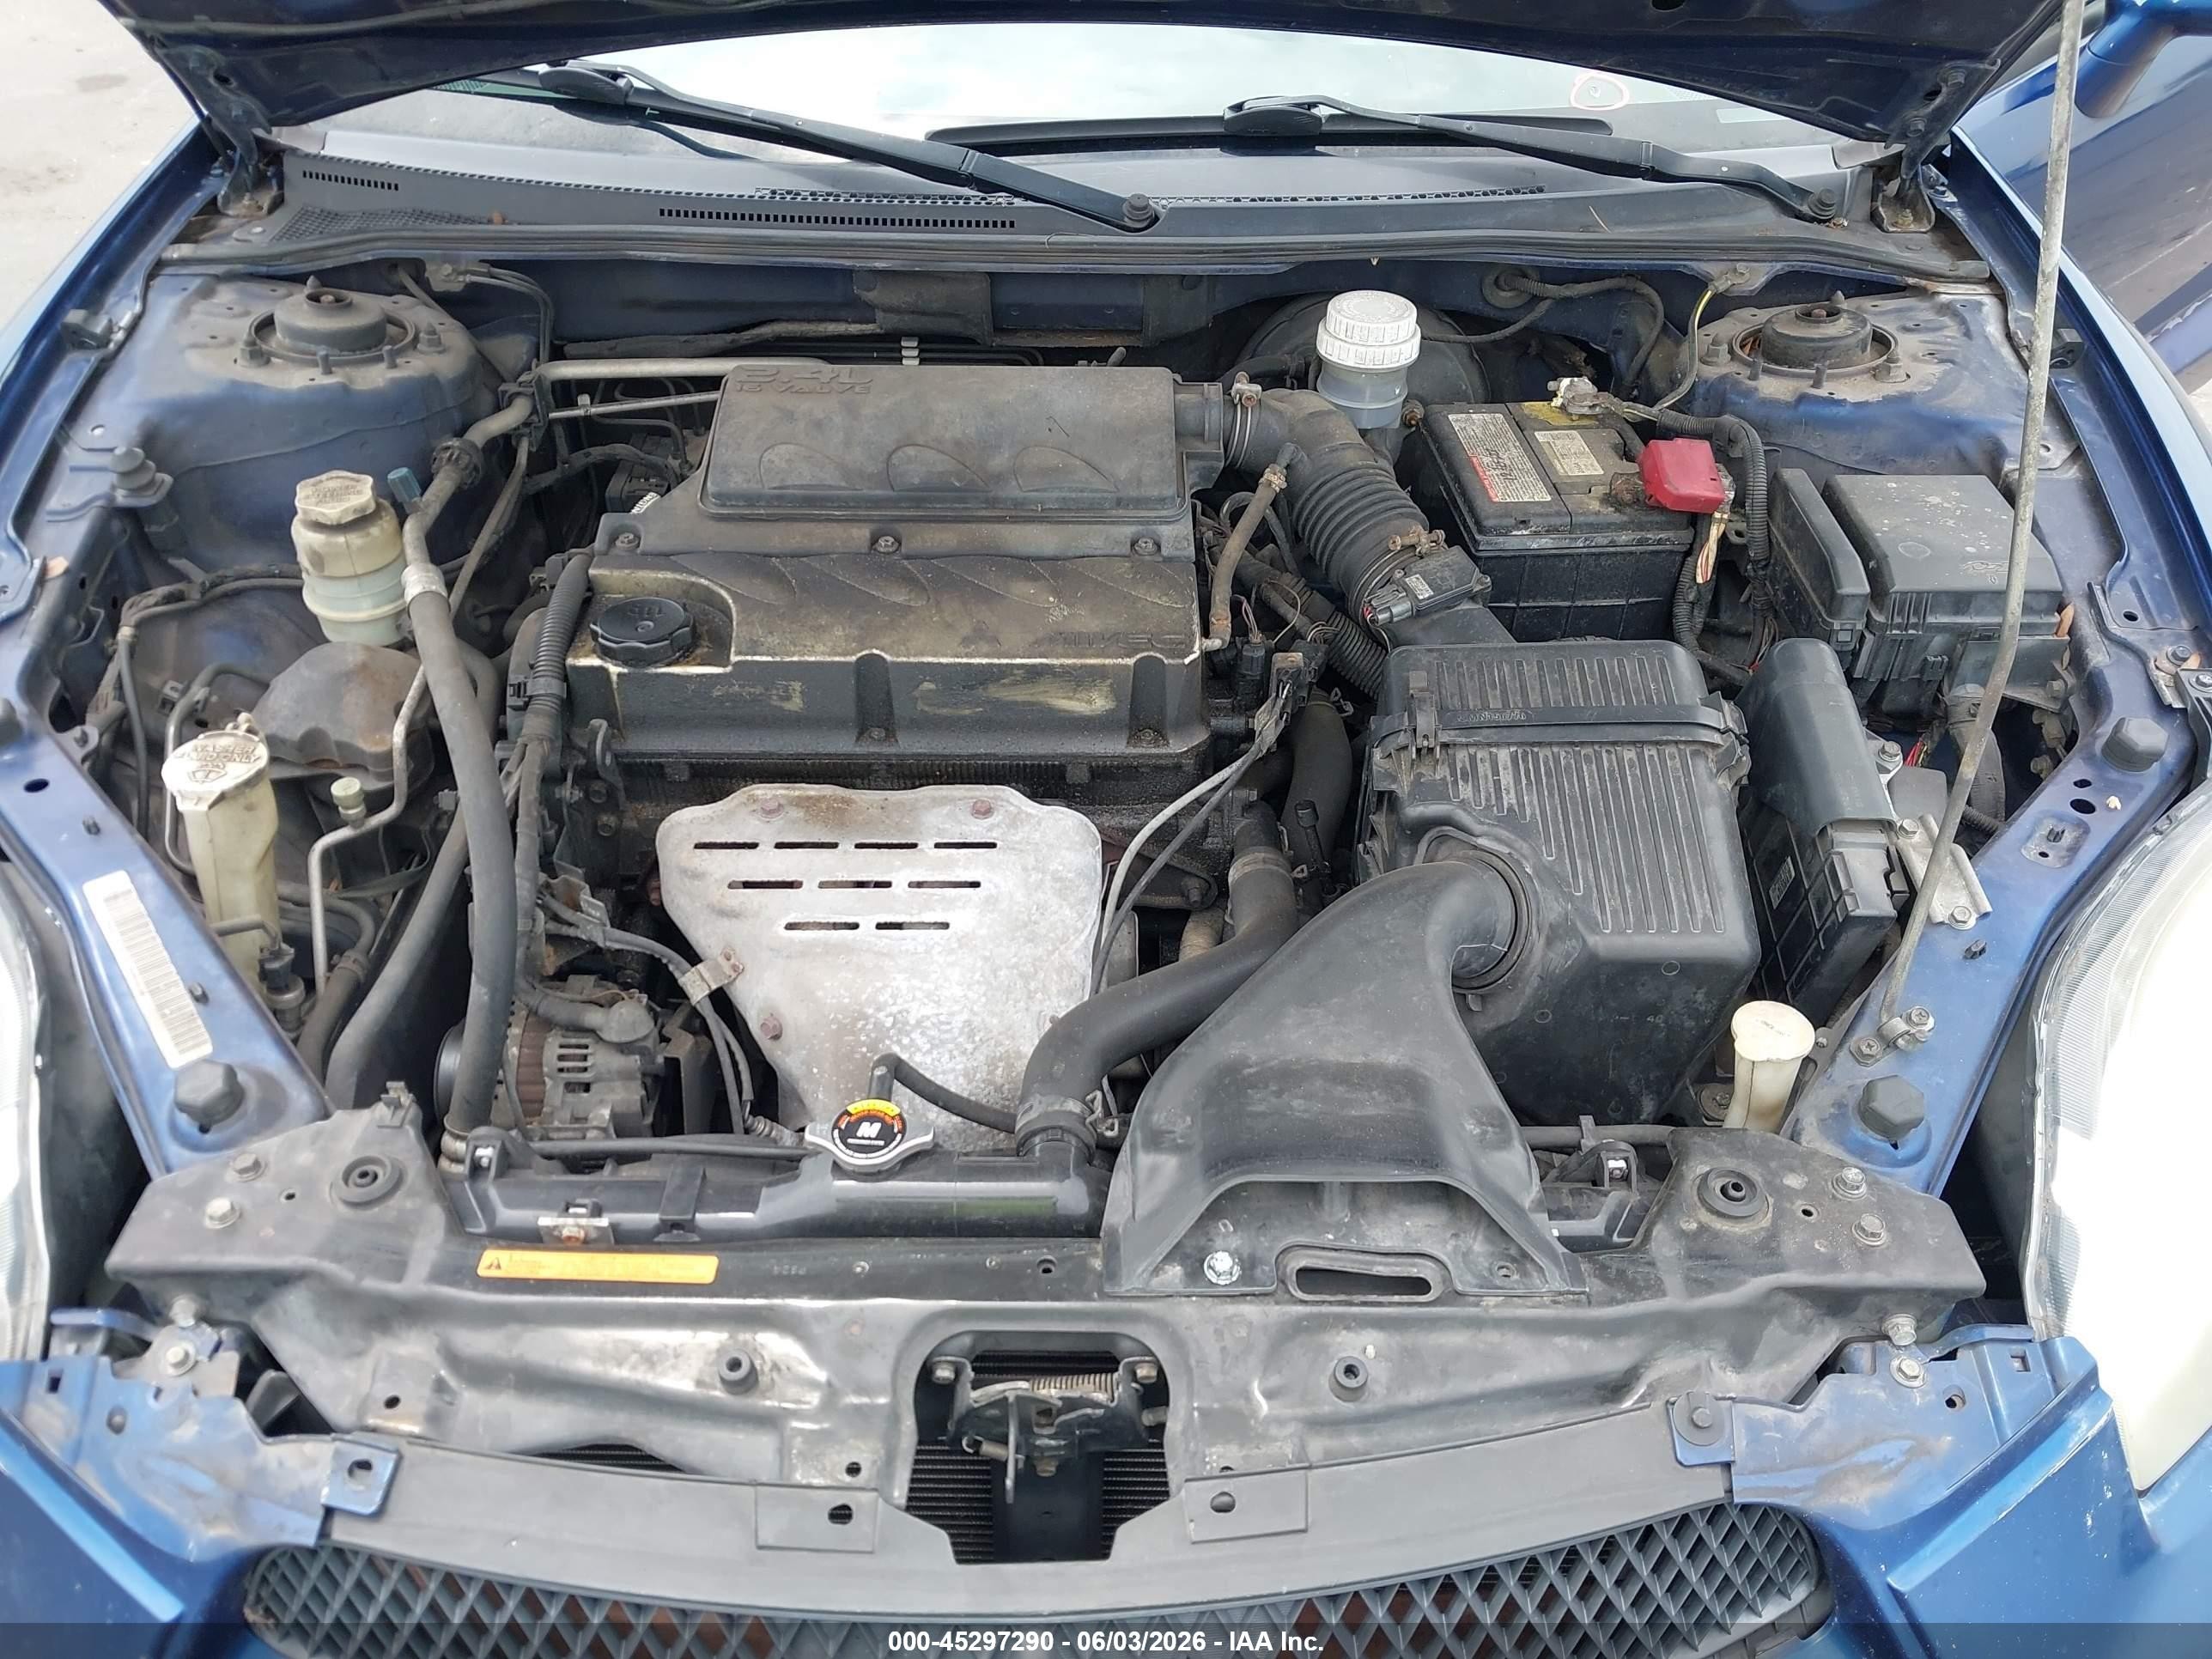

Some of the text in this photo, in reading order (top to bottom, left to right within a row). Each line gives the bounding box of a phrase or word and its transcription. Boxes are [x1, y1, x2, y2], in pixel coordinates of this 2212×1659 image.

[736, 368, 873, 385] 2.4L
[775, 384, 872, 394] VALVE
[221, 753, 262, 763] ONLY
